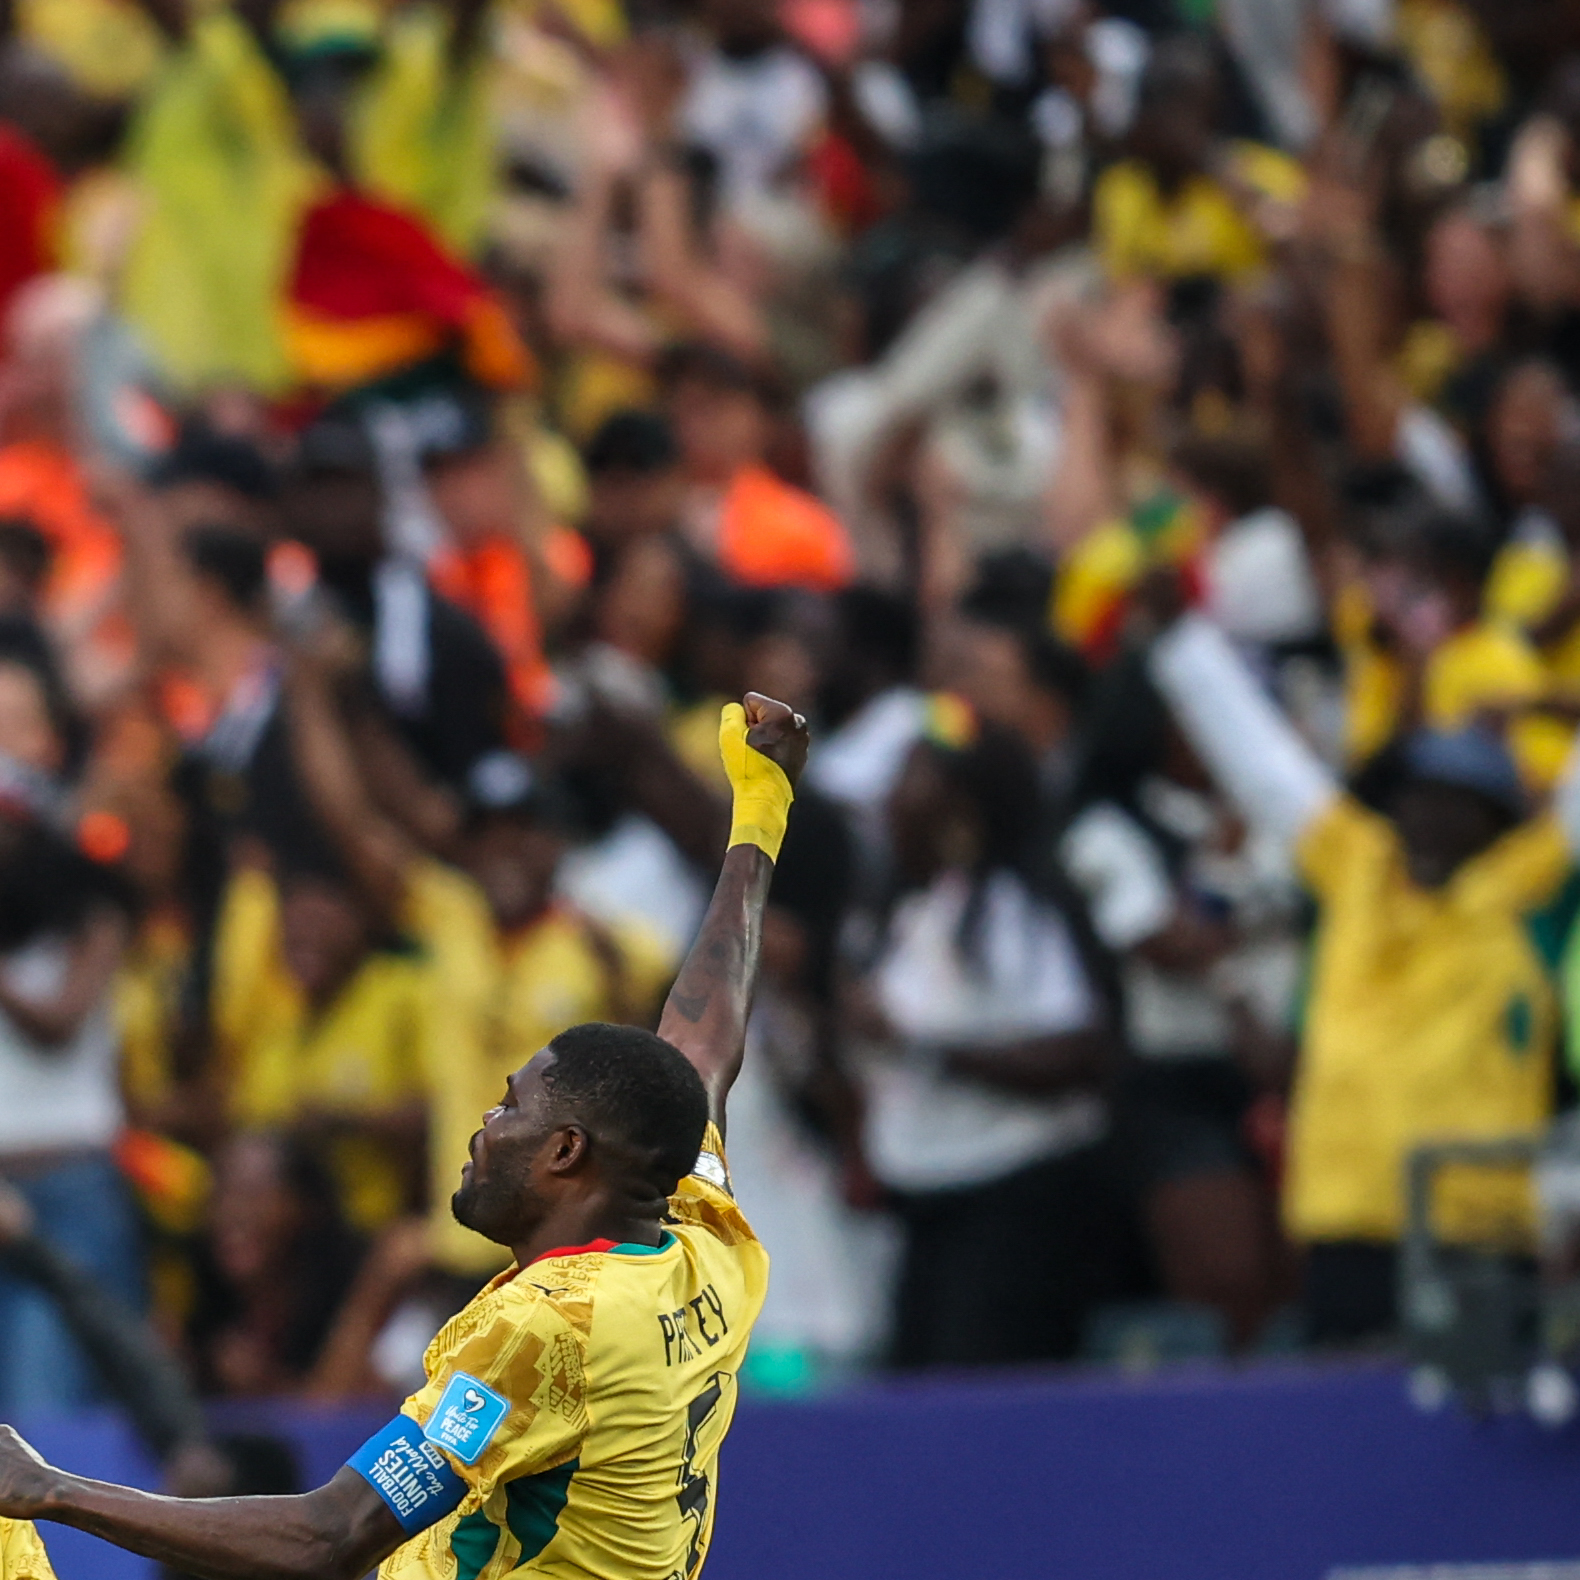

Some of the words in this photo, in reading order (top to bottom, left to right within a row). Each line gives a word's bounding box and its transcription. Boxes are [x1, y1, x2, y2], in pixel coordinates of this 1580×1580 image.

[440, 1418, 473, 1443] PEACE
[441, 1432, 458, 1446] FIFA
[390, 1435, 430, 1475] World
[368, 1462, 414, 1518] FOOTBALL
[378, 1449, 428, 1509] UNITES
[426, 1471, 445, 1496] the
